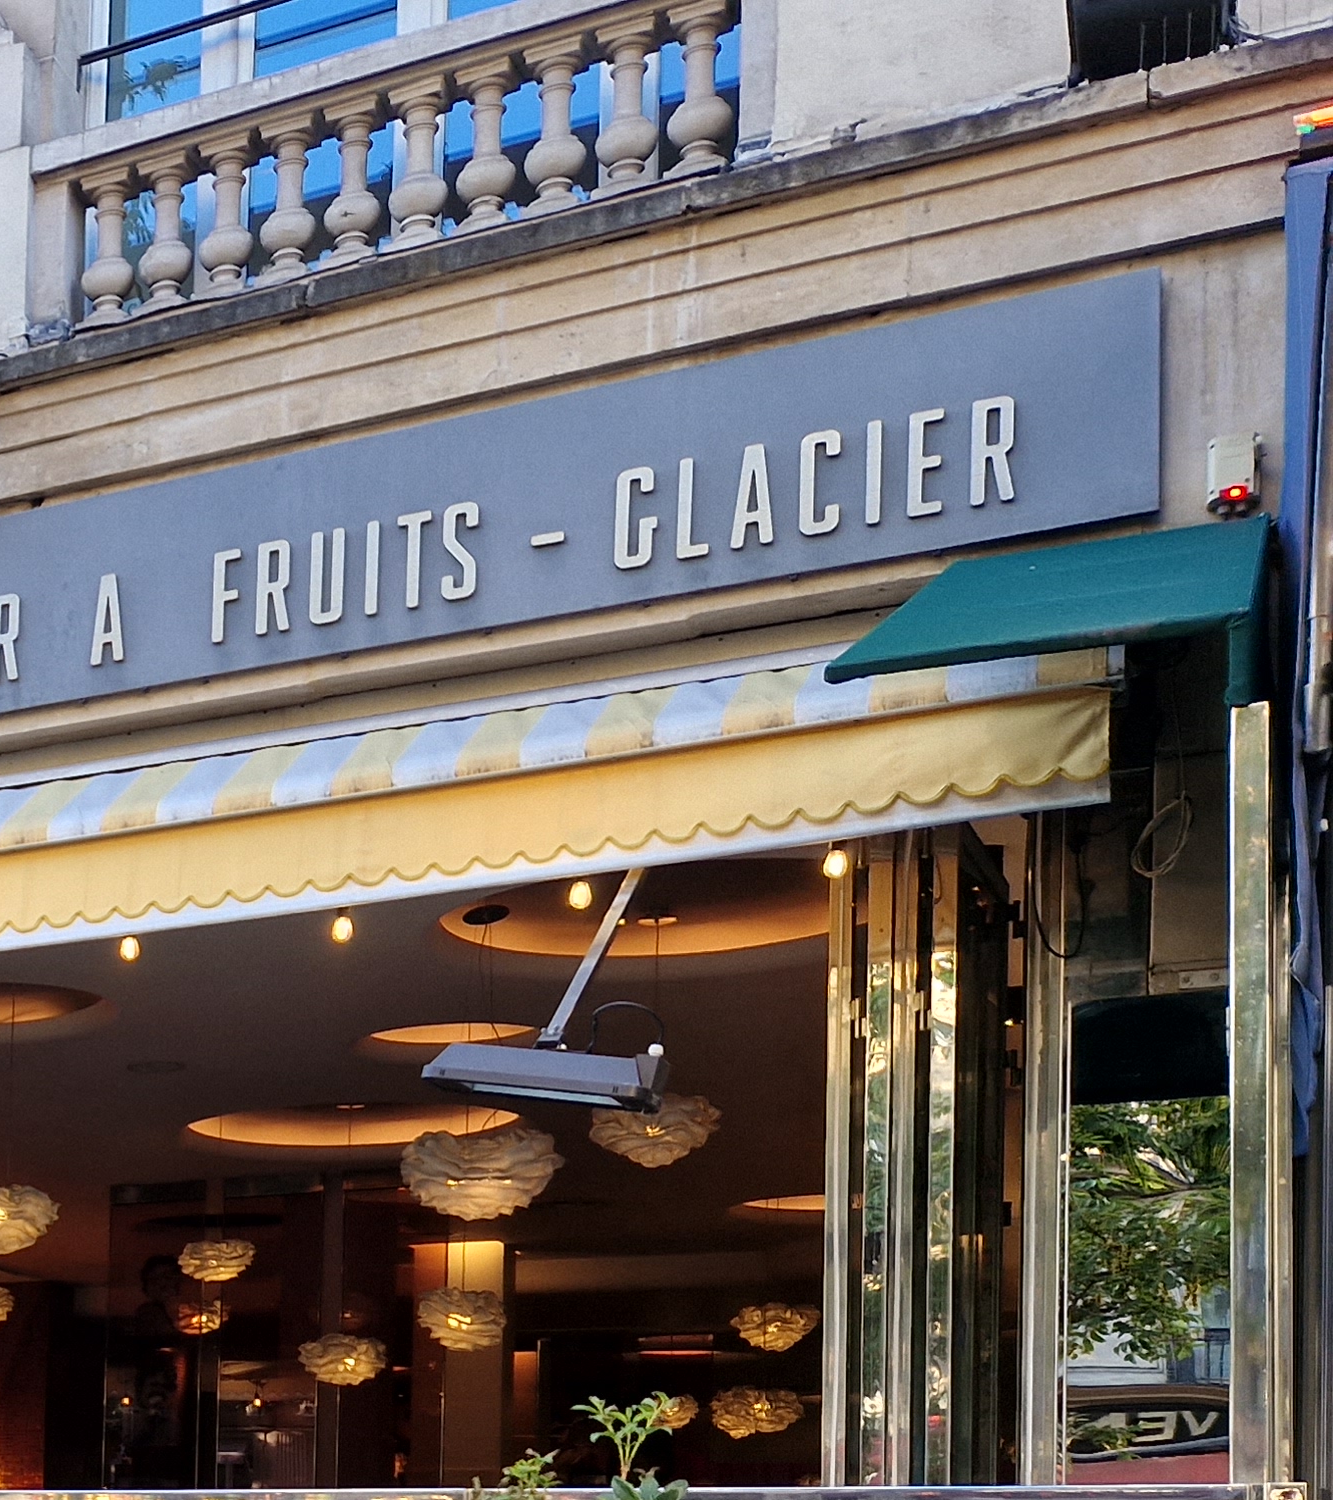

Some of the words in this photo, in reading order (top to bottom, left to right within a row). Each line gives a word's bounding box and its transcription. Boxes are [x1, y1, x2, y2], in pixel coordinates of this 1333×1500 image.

[90, 573, 125, 668] A
[211, 501, 480, 645] FRUITS
[613, 395, 1016, 570] GLACIER
